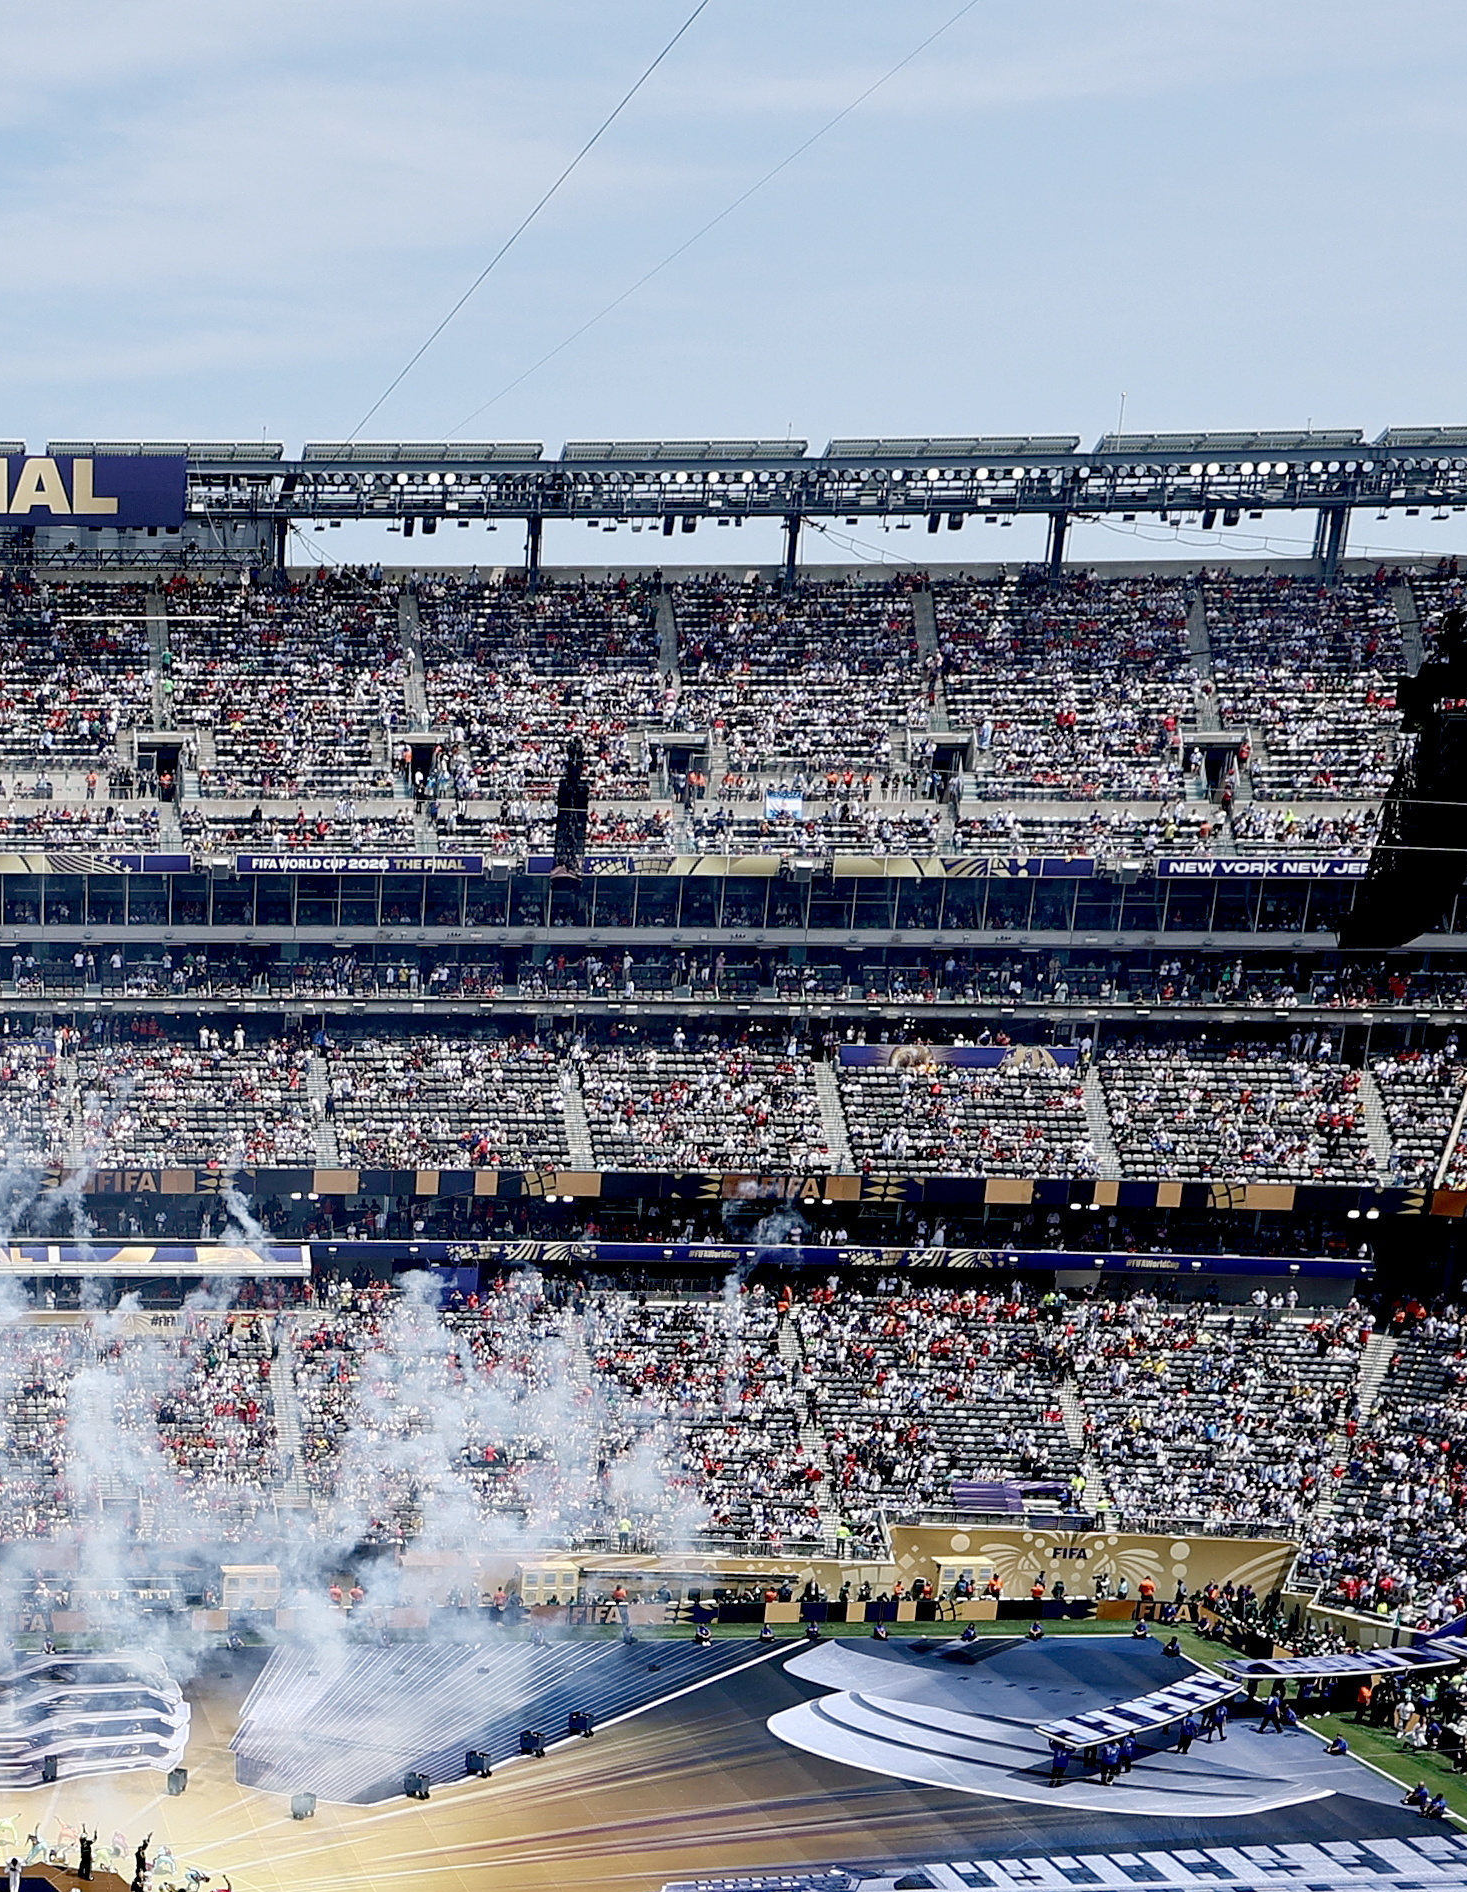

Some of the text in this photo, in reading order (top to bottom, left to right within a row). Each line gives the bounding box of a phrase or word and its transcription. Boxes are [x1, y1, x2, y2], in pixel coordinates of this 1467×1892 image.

[252, 859, 467, 870] FIFA WORLD CUP 2026 THE FINAL
[1169, 862, 1328, 874] NEW YORK NEW
[104, 1171, 156, 1192] FIFA
[760, 1175, 820, 1198] FIFA
[1052, 1547, 1088, 1560] FIFA
